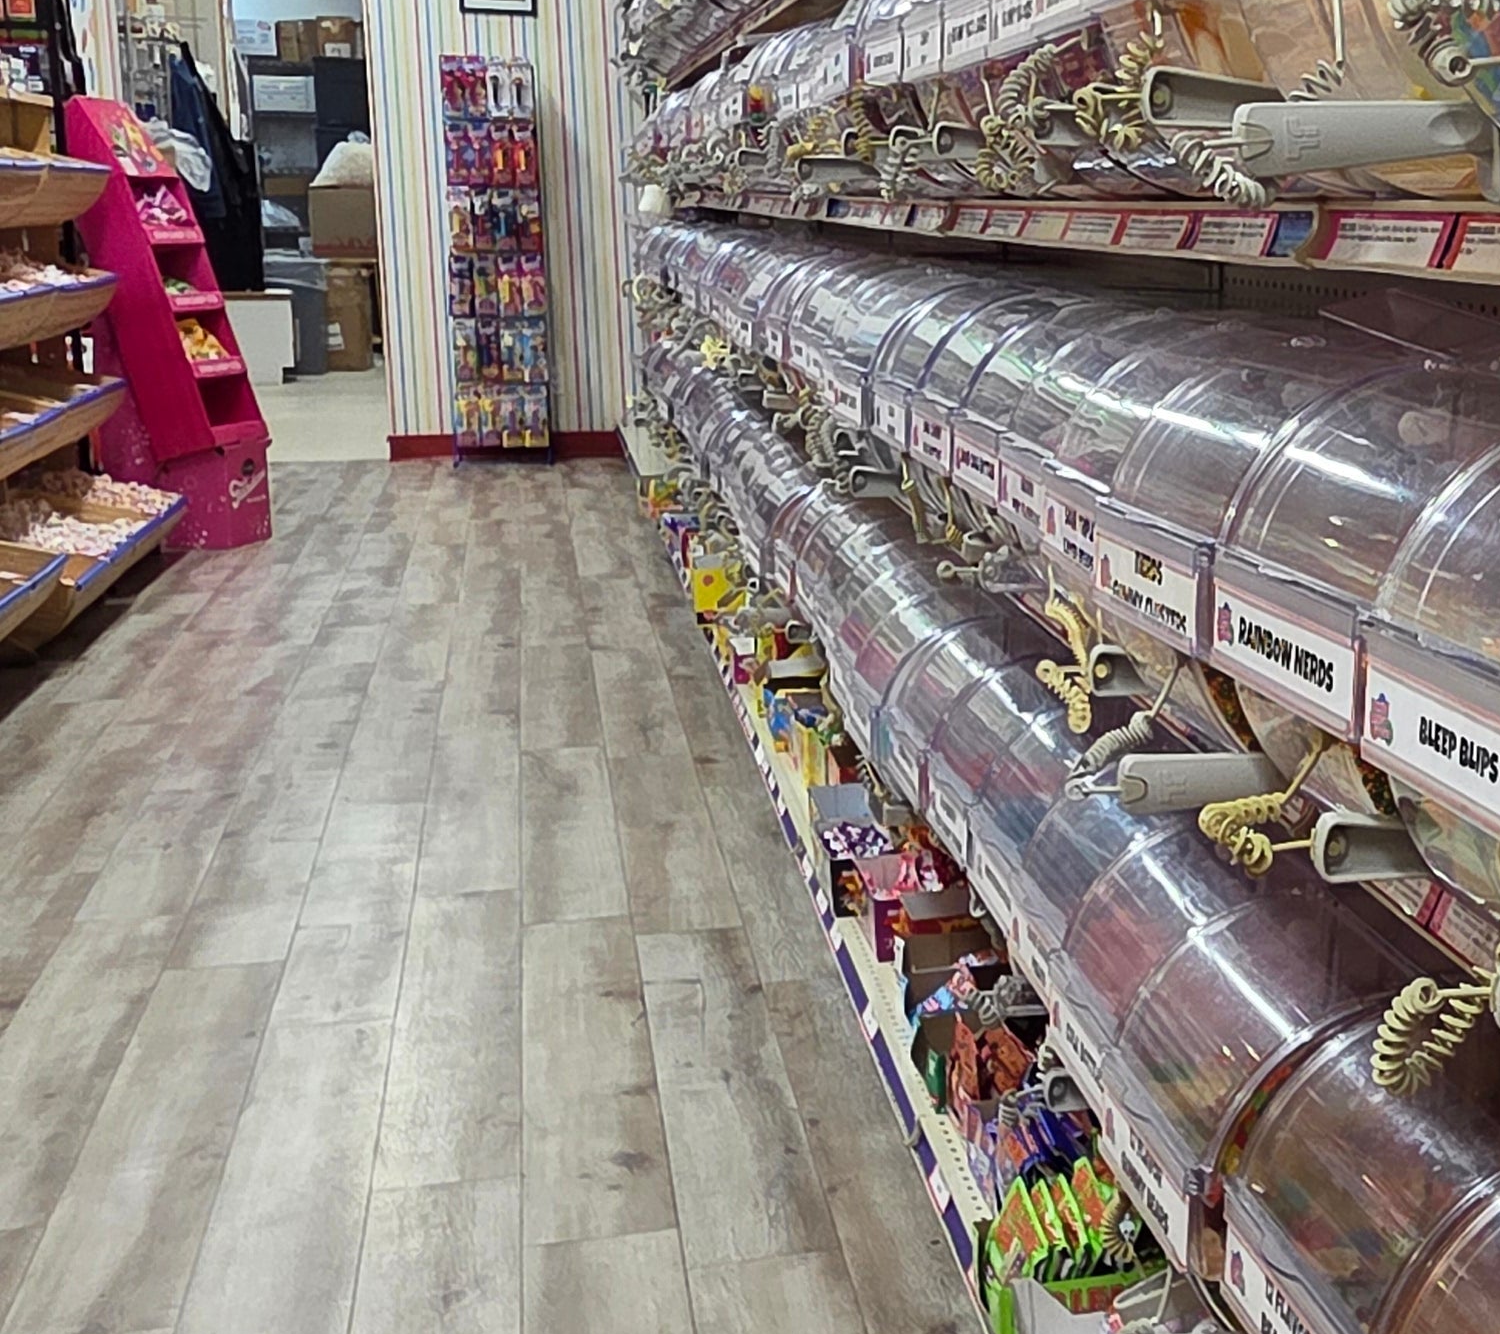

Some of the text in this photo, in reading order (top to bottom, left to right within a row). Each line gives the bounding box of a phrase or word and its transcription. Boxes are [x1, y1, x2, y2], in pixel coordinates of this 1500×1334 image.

[1239, 617, 1333, 692] RAINBOW NERDS
[1418, 715, 1499, 785] BLEEP BLIPS
